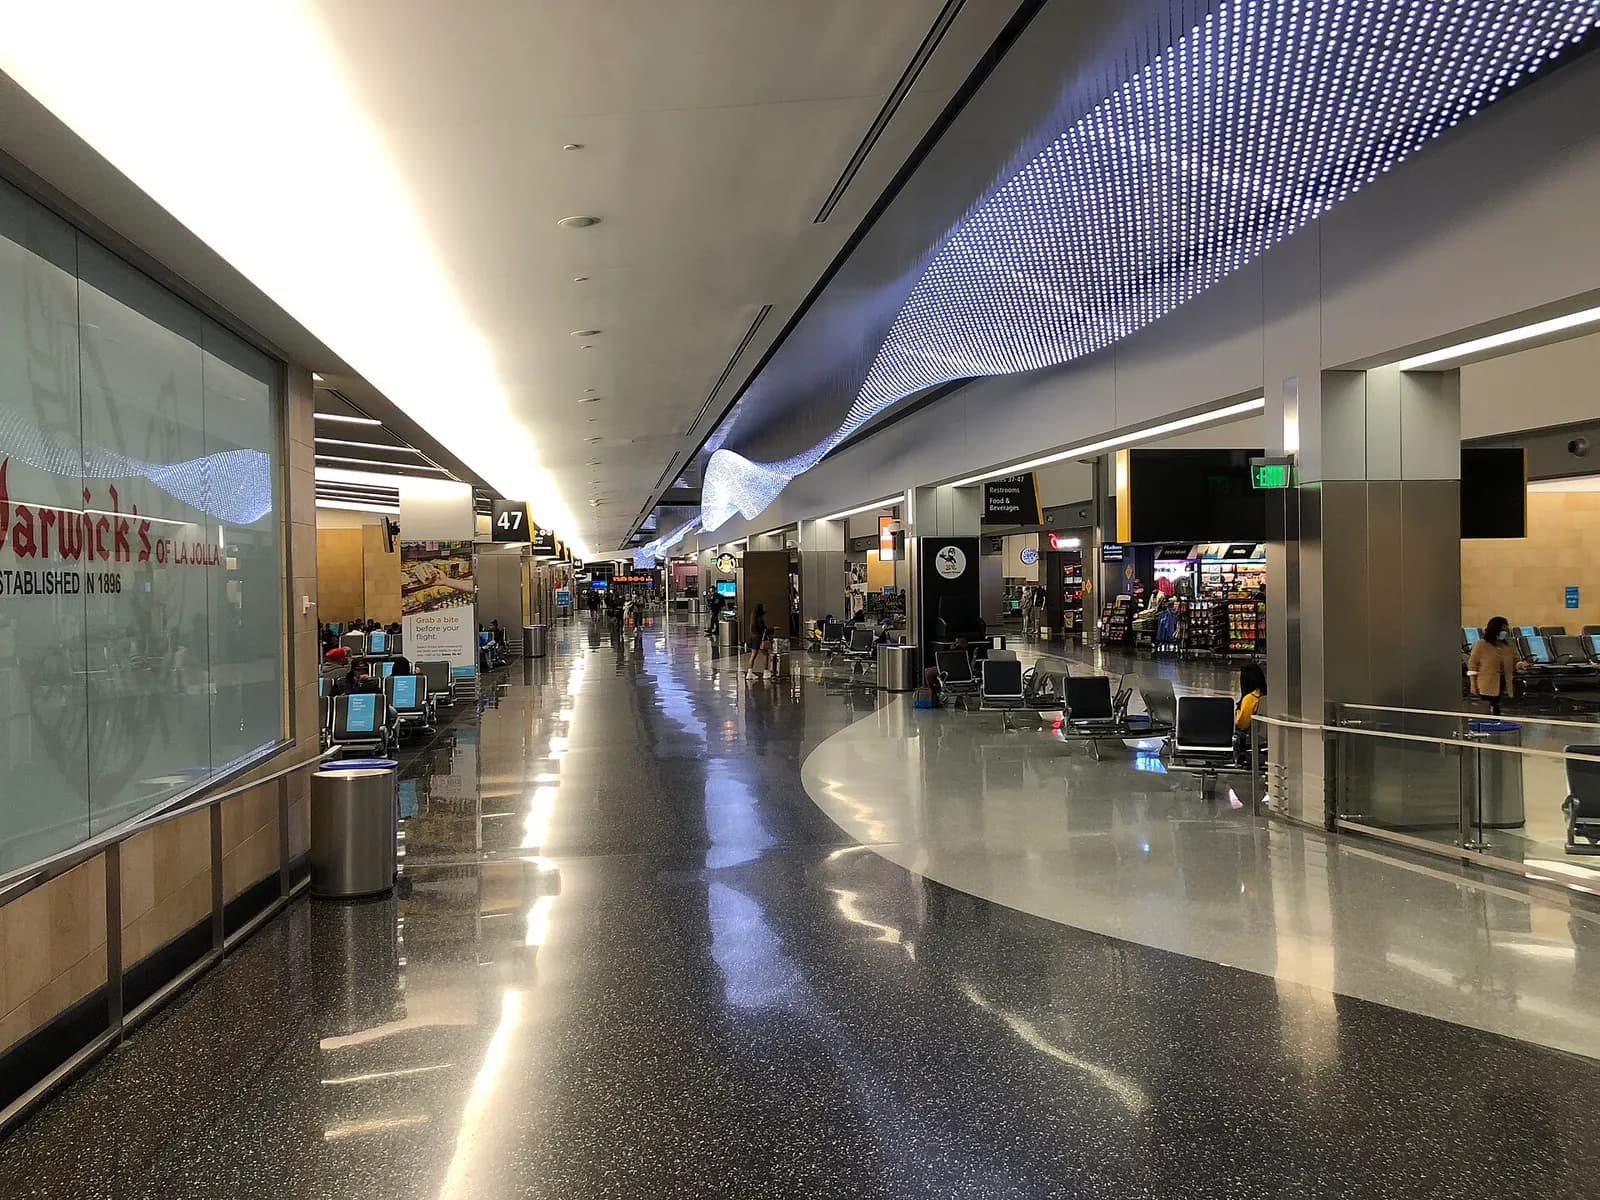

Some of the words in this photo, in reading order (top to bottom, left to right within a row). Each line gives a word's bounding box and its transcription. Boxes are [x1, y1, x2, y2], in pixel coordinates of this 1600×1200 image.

[497, 511, 523, 530] 47
[156, 539, 170, 564] OF
[174, 541, 187, 565] LA
[190, 543, 220, 566] JOLLA
[85, 572, 95, 594] N
[98, 572, 121, 594] 1896
[415, 616, 435, 624] Grab
